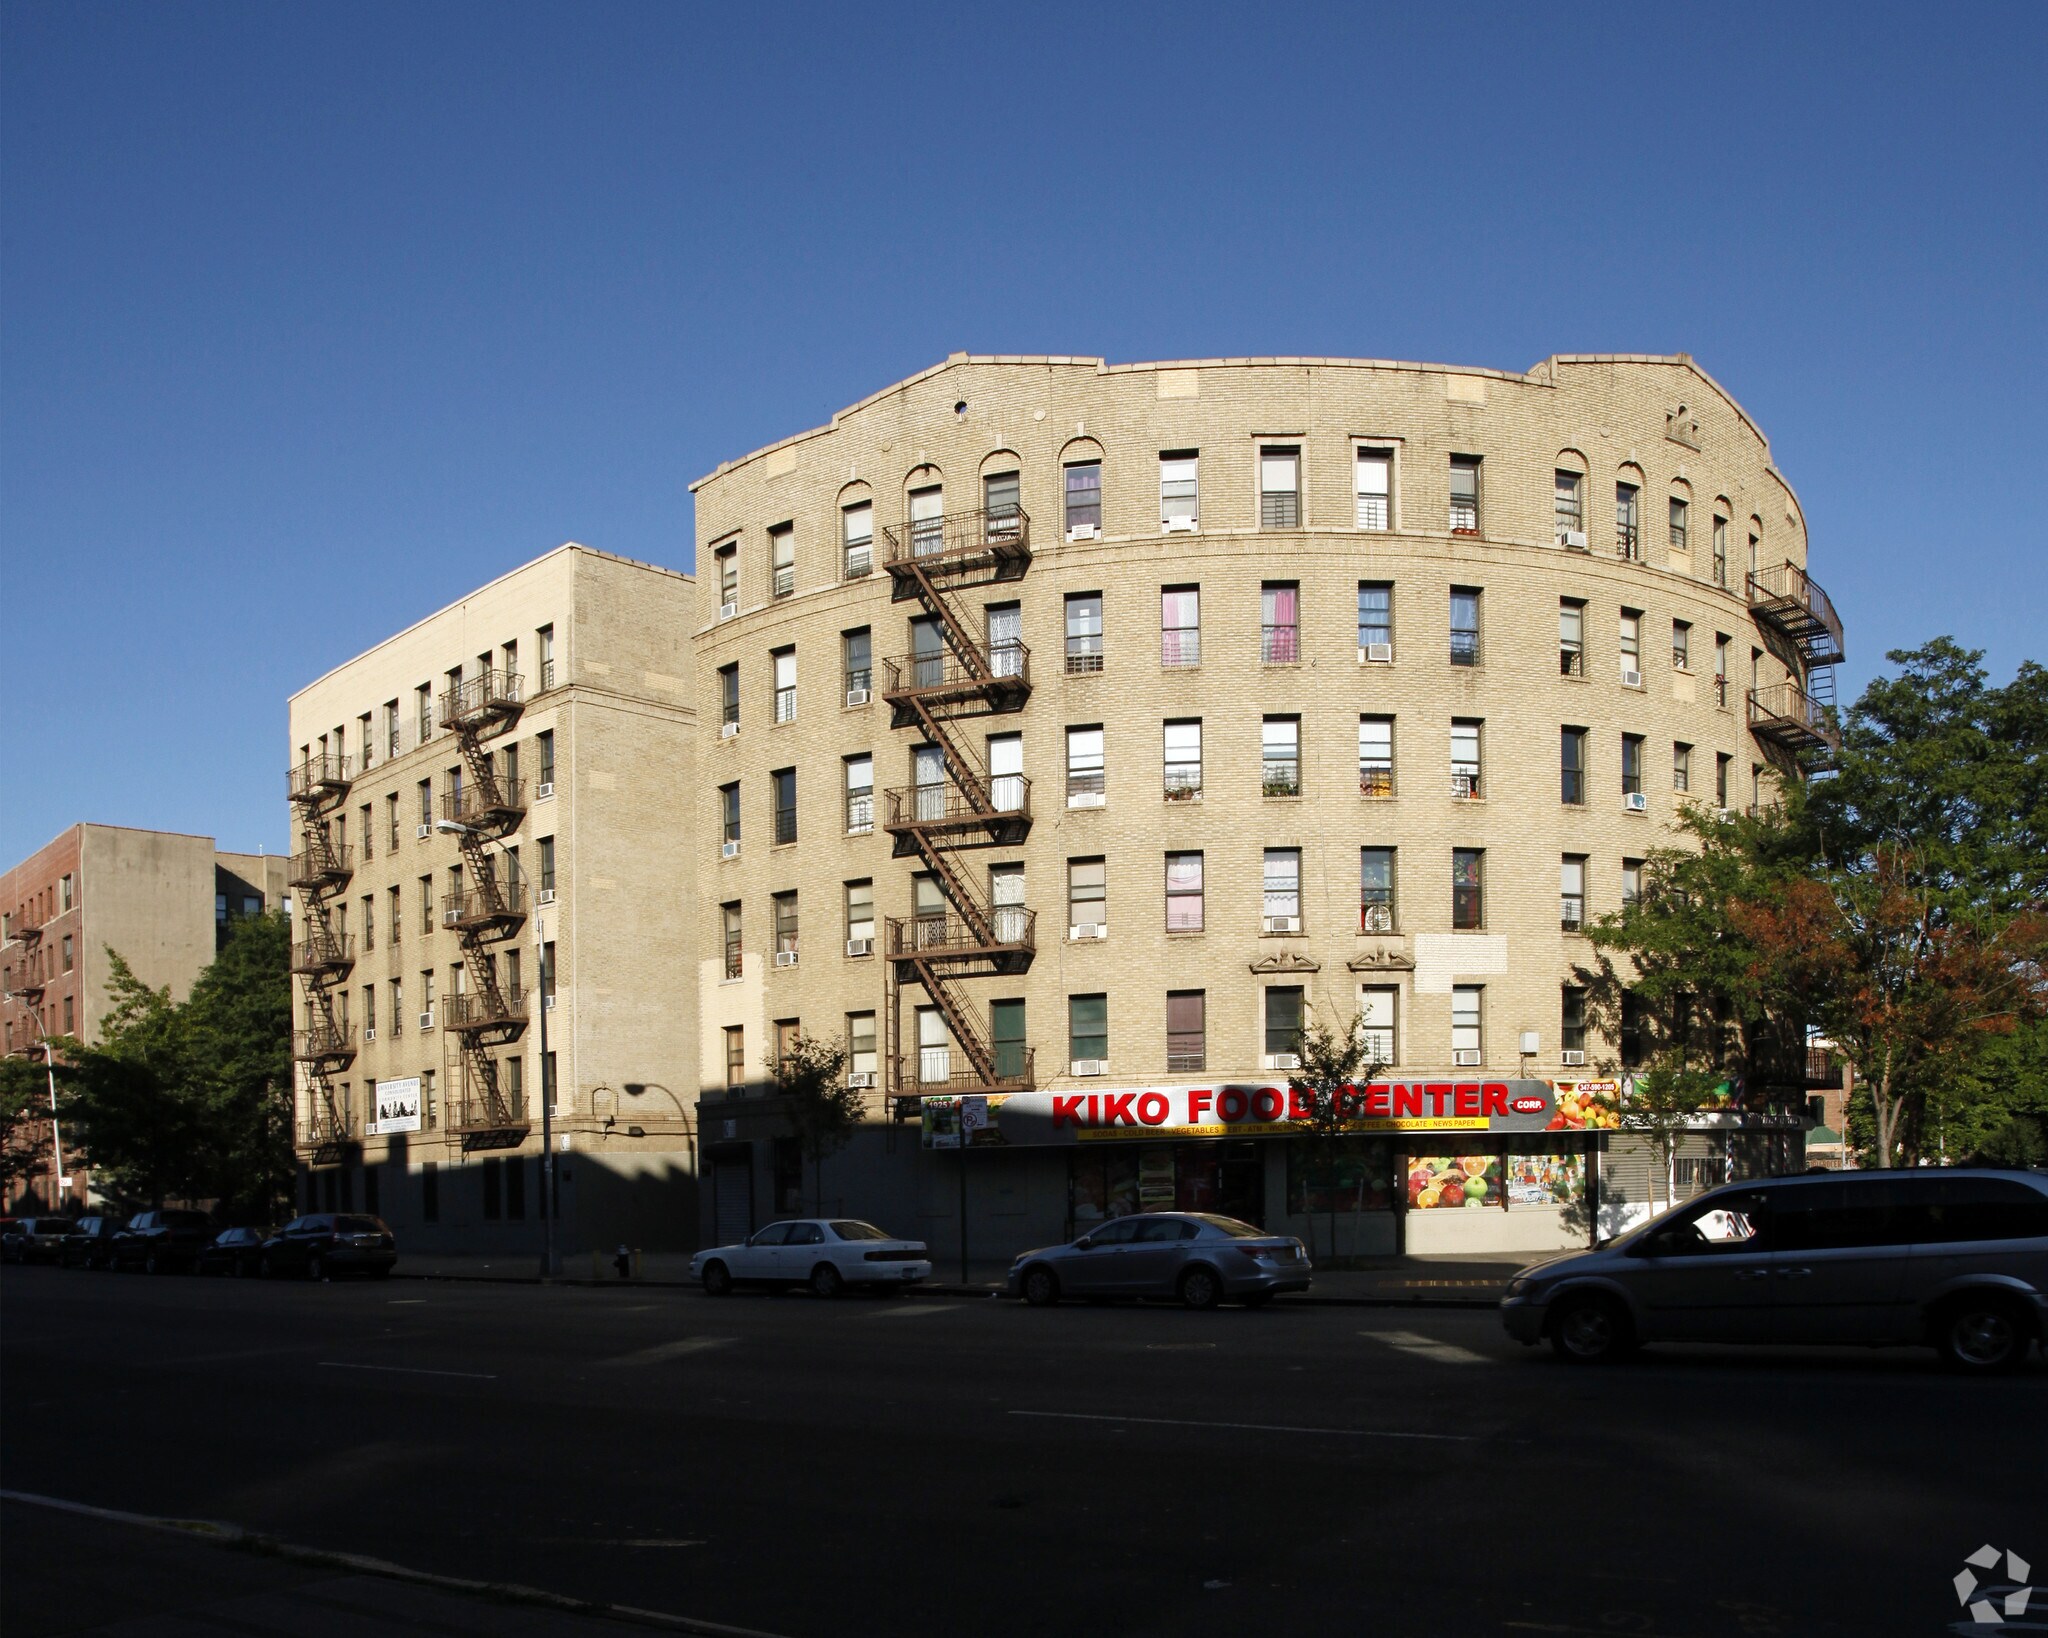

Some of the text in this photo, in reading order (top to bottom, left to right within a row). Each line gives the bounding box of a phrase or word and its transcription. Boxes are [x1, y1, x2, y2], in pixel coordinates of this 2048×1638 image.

[1053, 1084, 1542, 1128] KIKO FOOD CENTER CORP.
[1092, 1129, 1117, 1138] SODAS
[1123, 1128, 1145, 1137] COLD
[1146, 1127, 1166, 1136] BEER
[1171, 1126, 1220, 1135] VEGETABLES
[1228, 1125, 1243, 1133] EBT
[1247, 1124, 1263, 1133] ATM
[1385, 1119, 1428, 1128] CHOCOLATE
[1433, 1119, 1453, 1127] NEWS
[1454, 1119, 1476, 1127] PAPER
